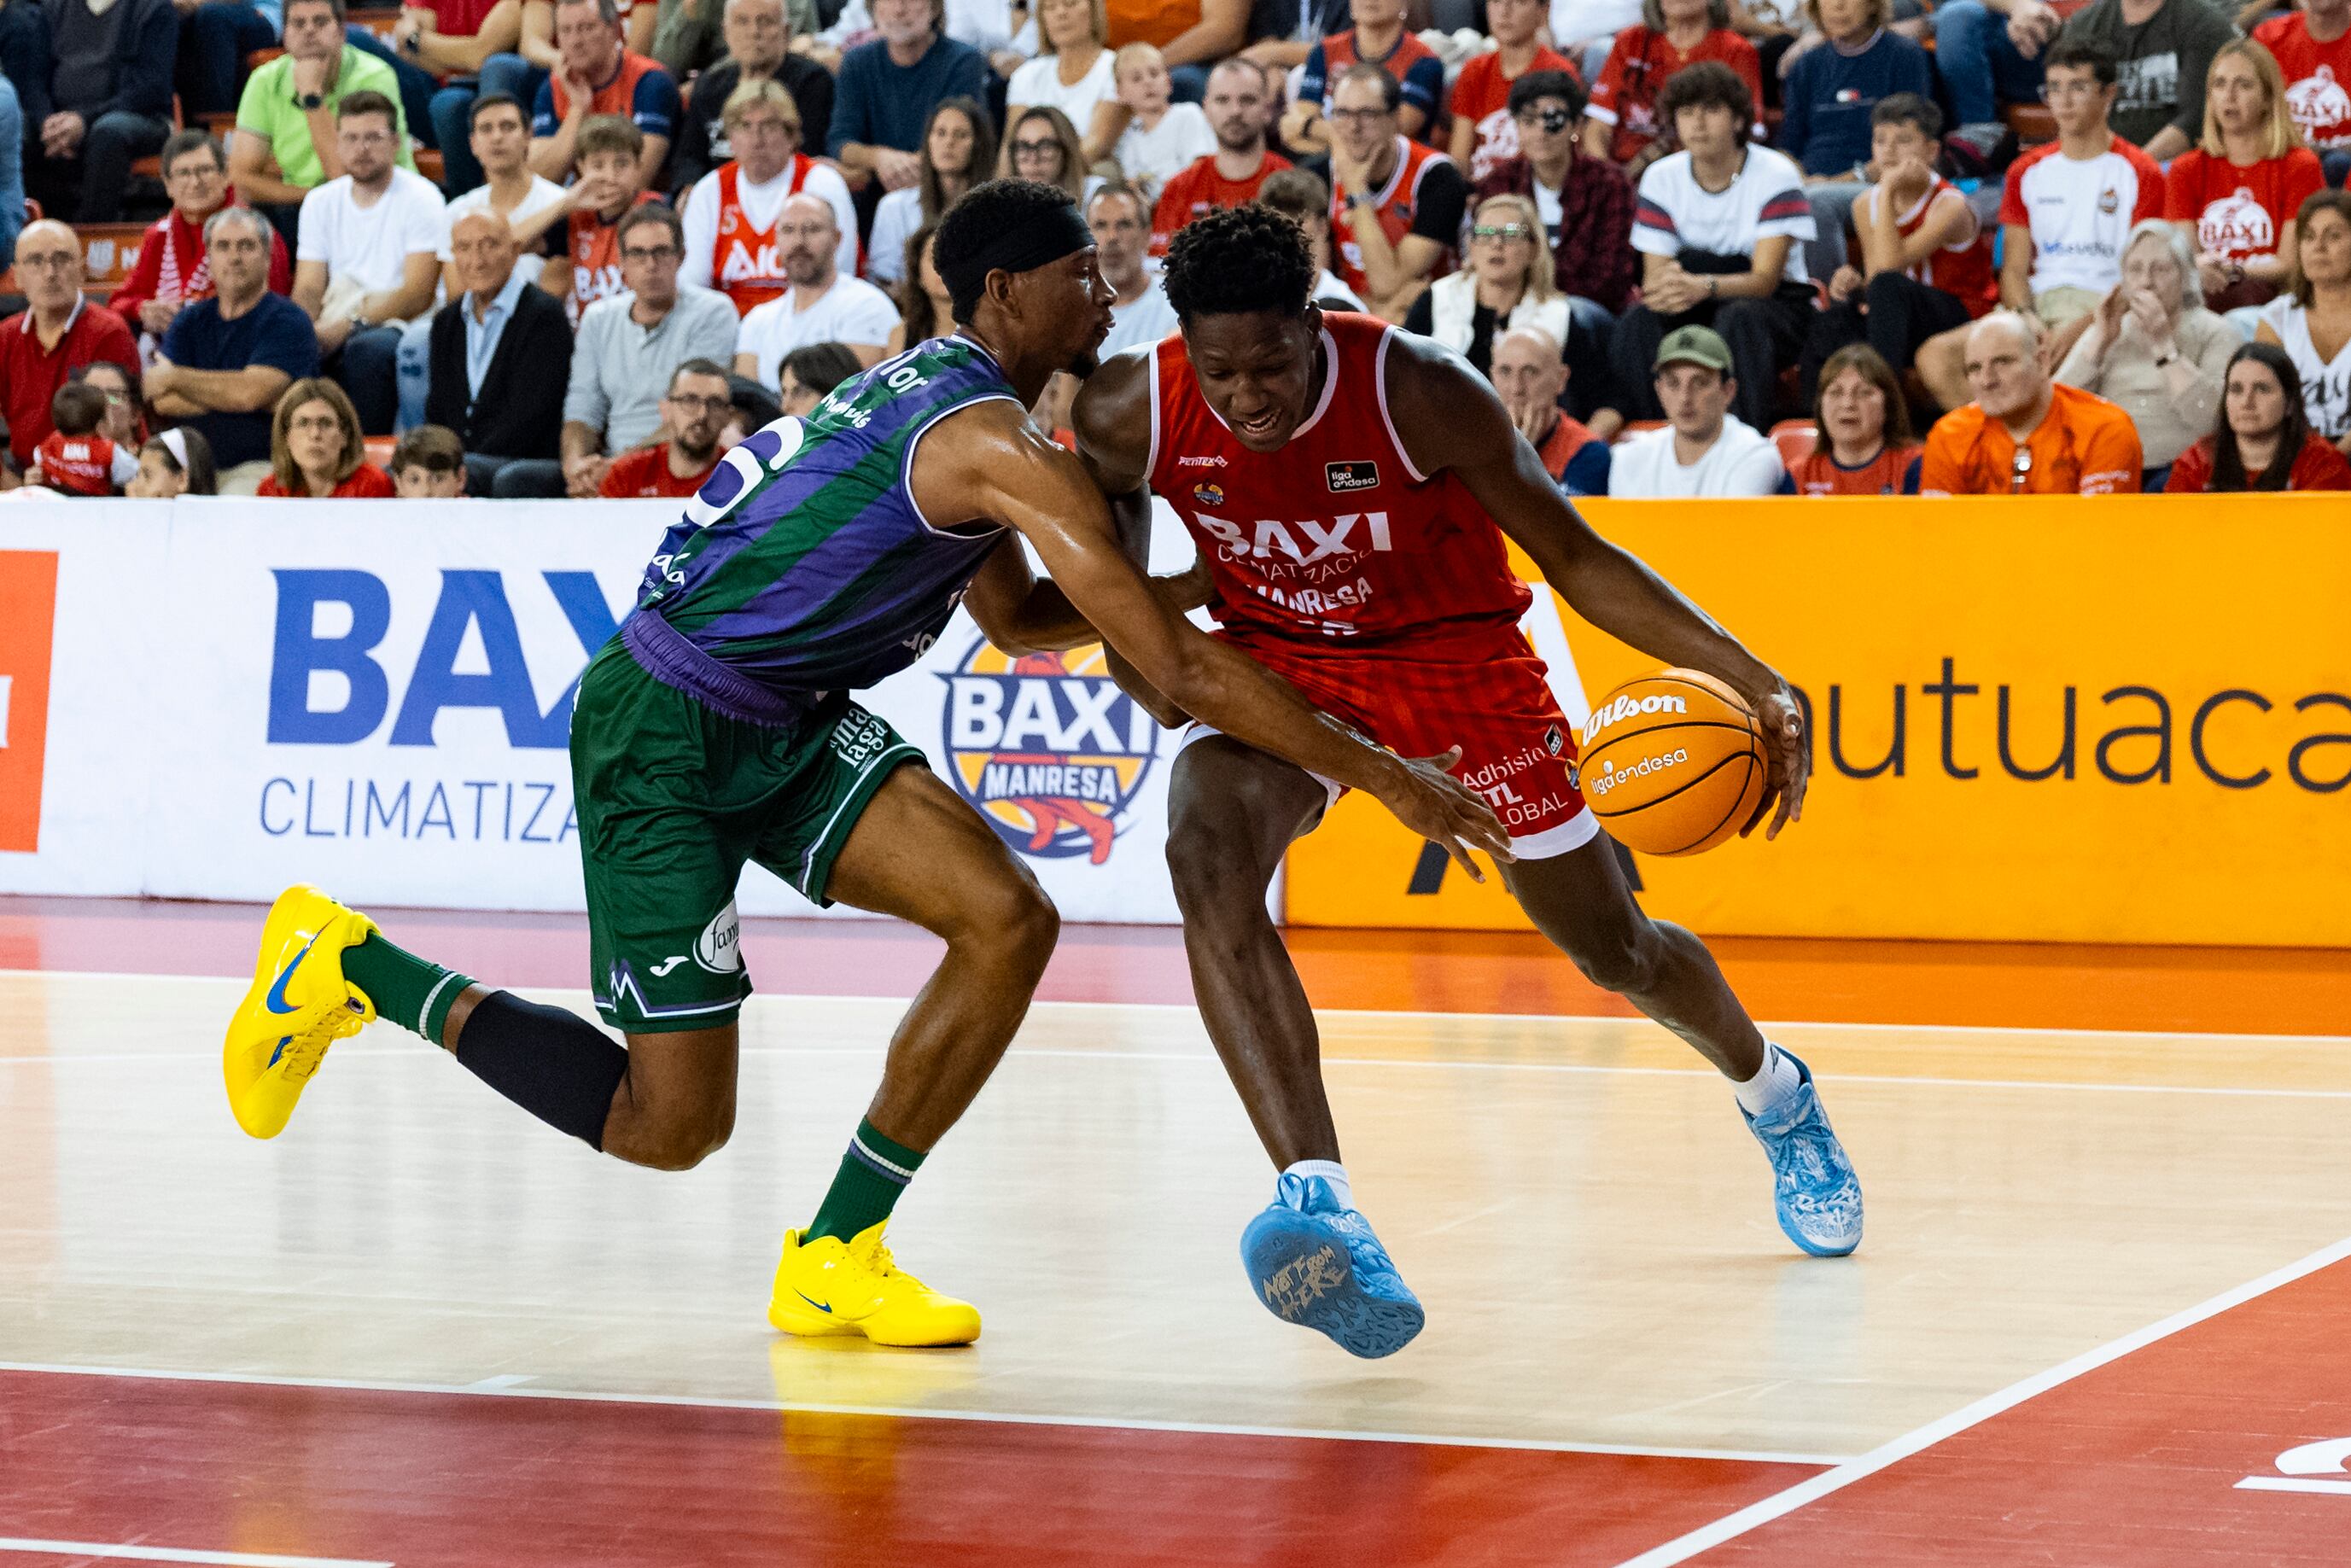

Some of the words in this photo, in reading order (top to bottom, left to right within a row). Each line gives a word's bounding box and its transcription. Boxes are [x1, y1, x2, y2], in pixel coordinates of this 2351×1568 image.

[2202, 222, 2269, 242] BAXI
[866, 348, 929, 394] lor
[1332, 471, 1351, 481] liga
[1333, 477, 1375, 488] endesa
[1191, 510, 1392, 567] BAXI
[265, 567, 639, 749] BAX
[949, 677, 1152, 754] BAXI
[1582, 695, 1688, 748] Wilson
[985, 764, 1117, 804] MANRESA
[1462, 748, 1546, 789] Adbisio
[1590, 775, 1616, 796] liga
[1615, 748, 1689, 784] endesa
[1476, 782, 1524, 807] TL
[1501, 791, 1569, 828] OBAL
